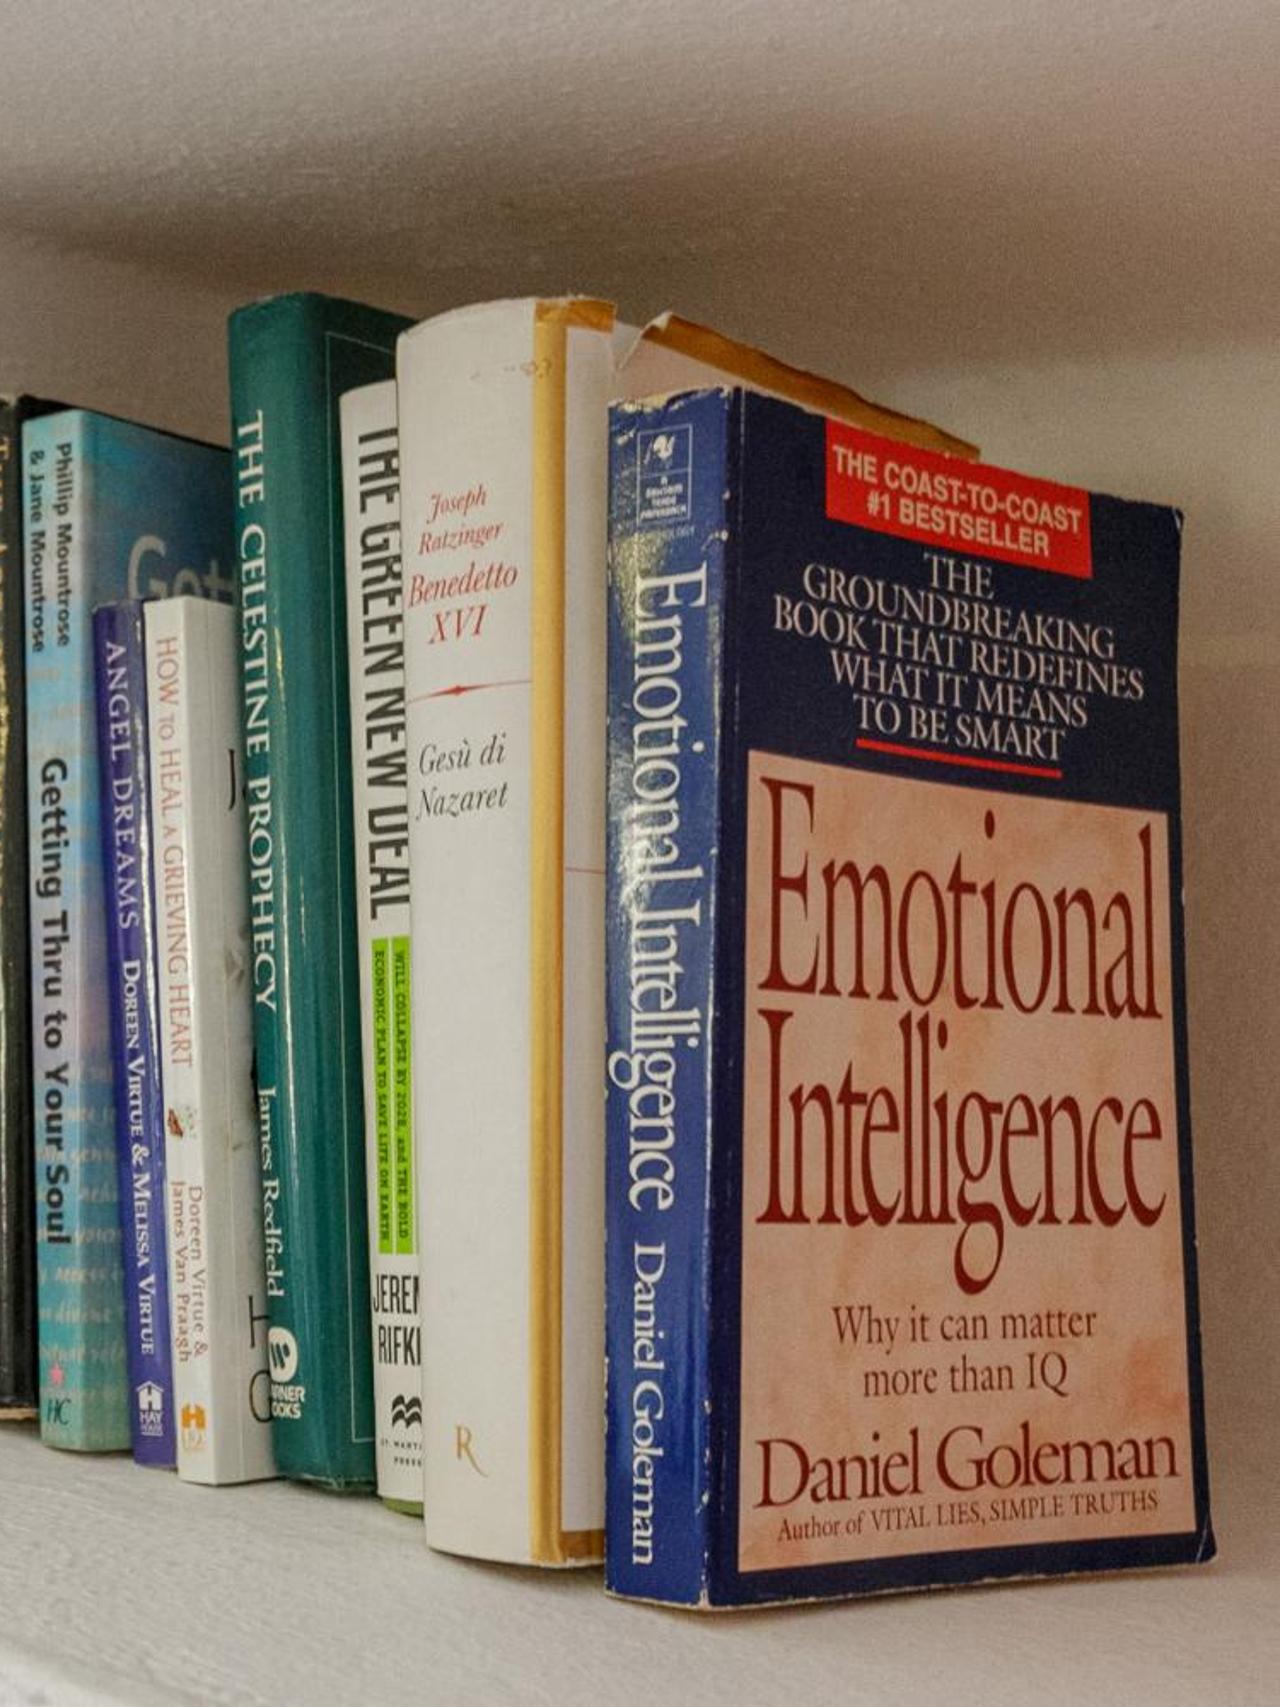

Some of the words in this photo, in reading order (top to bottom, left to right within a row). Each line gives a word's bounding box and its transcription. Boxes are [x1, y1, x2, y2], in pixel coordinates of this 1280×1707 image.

[30, 451, 45, 465] &
[53, 442, 72, 516] Phillip
[237, 409, 265, 509] THE
[832, 445, 877, 483] THE
[884, 461, 1081, 534] COAST-TO-COAST
[30, 474, 45, 524] Jane
[426, 483, 488, 525] Joseph
[867, 491, 892, 520] #1
[899, 499, 1049, 556] BESTSELLER
[419, 520, 504, 556] Ratzinger
[31, 530, 46, 653] Mountrose
[57, 523, 72, 647] Mountrose
[360, 521, 405, 677] GREEN
[408, 561, 519, 608] Benedetto
[803, 562, 1114, 659] GROUNDBREAKING
[924, 552, 994, 599] THE
[240, 523, 270, 759] CELESTINE
[427, 604, 489, 644] XVI
[774, 594, 868, 651] BOOK
[873, 617, 964, 669] THAT
[969, 639, 1144, 699] REDEFINES
[106, 641, 131, 761] ANGEL
[155, 637, 179, 704] HOW
[831, 649, 929, 699] WHAT
[938, 670, 968, 707] IT
[975, 680, 1088, 727] MEANS
[158, 713, 175, 741] TO
[364, 687, 408, 788] NEW
[419, 739, 470, 776] Gesù
[479, 732, 506, 765] di
[632, 562, 708, 882] Emotional
[853, 693, 900, 734] TO
[909, 705, 948, 744] BE
[956, 713, 1065, 760] SMART
[159, 748, 182, 818] HEAL
[415, 782, 508, 821] Nazaret
[36, 758, 70, 899] Getting
[112, 778, 140, 930] DREAMS
[163, 826, 174, 838] A
[368, 805, 411, 921] DEAL
[163, 845, 188, 974] GRIEVING
[247, 773, 277, 1013] PROPHECY
[757, 776, 1162, 1020] Emotional
[42, 910, 70, 998] Thru
[374, 950, 386, 1024] ECONOMIC
[395, 954, 406, 987] WILL
[44, 1009, 68, 1049] to
[122, 959, 141, 1049] DOREEN
[169, 985, 193, 1069] HEART
[395, 993, 407, 1063] COLLAPSE
[376, 1028, 386, 1066] PLAN
[377, 1070, 387, 1089] TO
[397, 1068, 407, 1086] BY
[608, 900, 701, 1212] Intelligence
[45, 1063, 69, 1151] Your
[127, 1055, 146, 1138] VIRTUE
[258, 1086, 277, 1172] James
[378, 1093, 388, 1126] SAVE
[131, 1143, 150, 1166] &
[378, 1133, 389, 1163] LIFE
[379, 1169, 389, 1189] ON
[398, 1169, 408, 1195] THE
[755, 1009, 1166, 1295] Intelligence
[46, 1165, 71, 1243] Soul
[132, 1174, 151, 1268] MELISSA
[171, 1180, 186, 1238] James
[188, 1186, 203, 1260] Doreen
[262, 1178, 285, 1299] Redfield
[379, 1194, 390, 1240] EARTH
[398, 1201, 409, 1239] BOLD
[175, 1245, 189, 1284] Van
[138, 1273, 157, 1355] VIRTUE
[175, 1294, 192, 1364] Praagh
[192, 1269, 208, 1335] Virtue
[632, 1242, 666, 1370] Daniel
[832, 1305, 899, 1355] Why
[910, 1305, 930, 1342] it
[939, 1314, 989, 1342] can
[1000, 1306, 1097, 1341] matter
[193, 1340, 208, 1359] &
[378, 1324, 421, 1366] RIFKI
[864, 1367, 937, 1397] more
[950, 1354, 1014, 1392] than
[1027, 1352, 1069, 1398] IQ
[271, 1402, 301, 1419] OOKS
[632, 1381, 665, 1565] Goleman
[755, 1427, 922, 1508] Daniel
[937, 1421, 1181, 1492] Goleman
[778, 1518, 841, 1542] Author
[846, 1511, 867, 1534] of
[870, 1505, 931, 1532] VITAL
[937, 1500, 986, 1526] LIES,
[990, 1494, 1065, 1522] SIMPLE
[1069, 1490, 1160, 1518] TRUTHS
